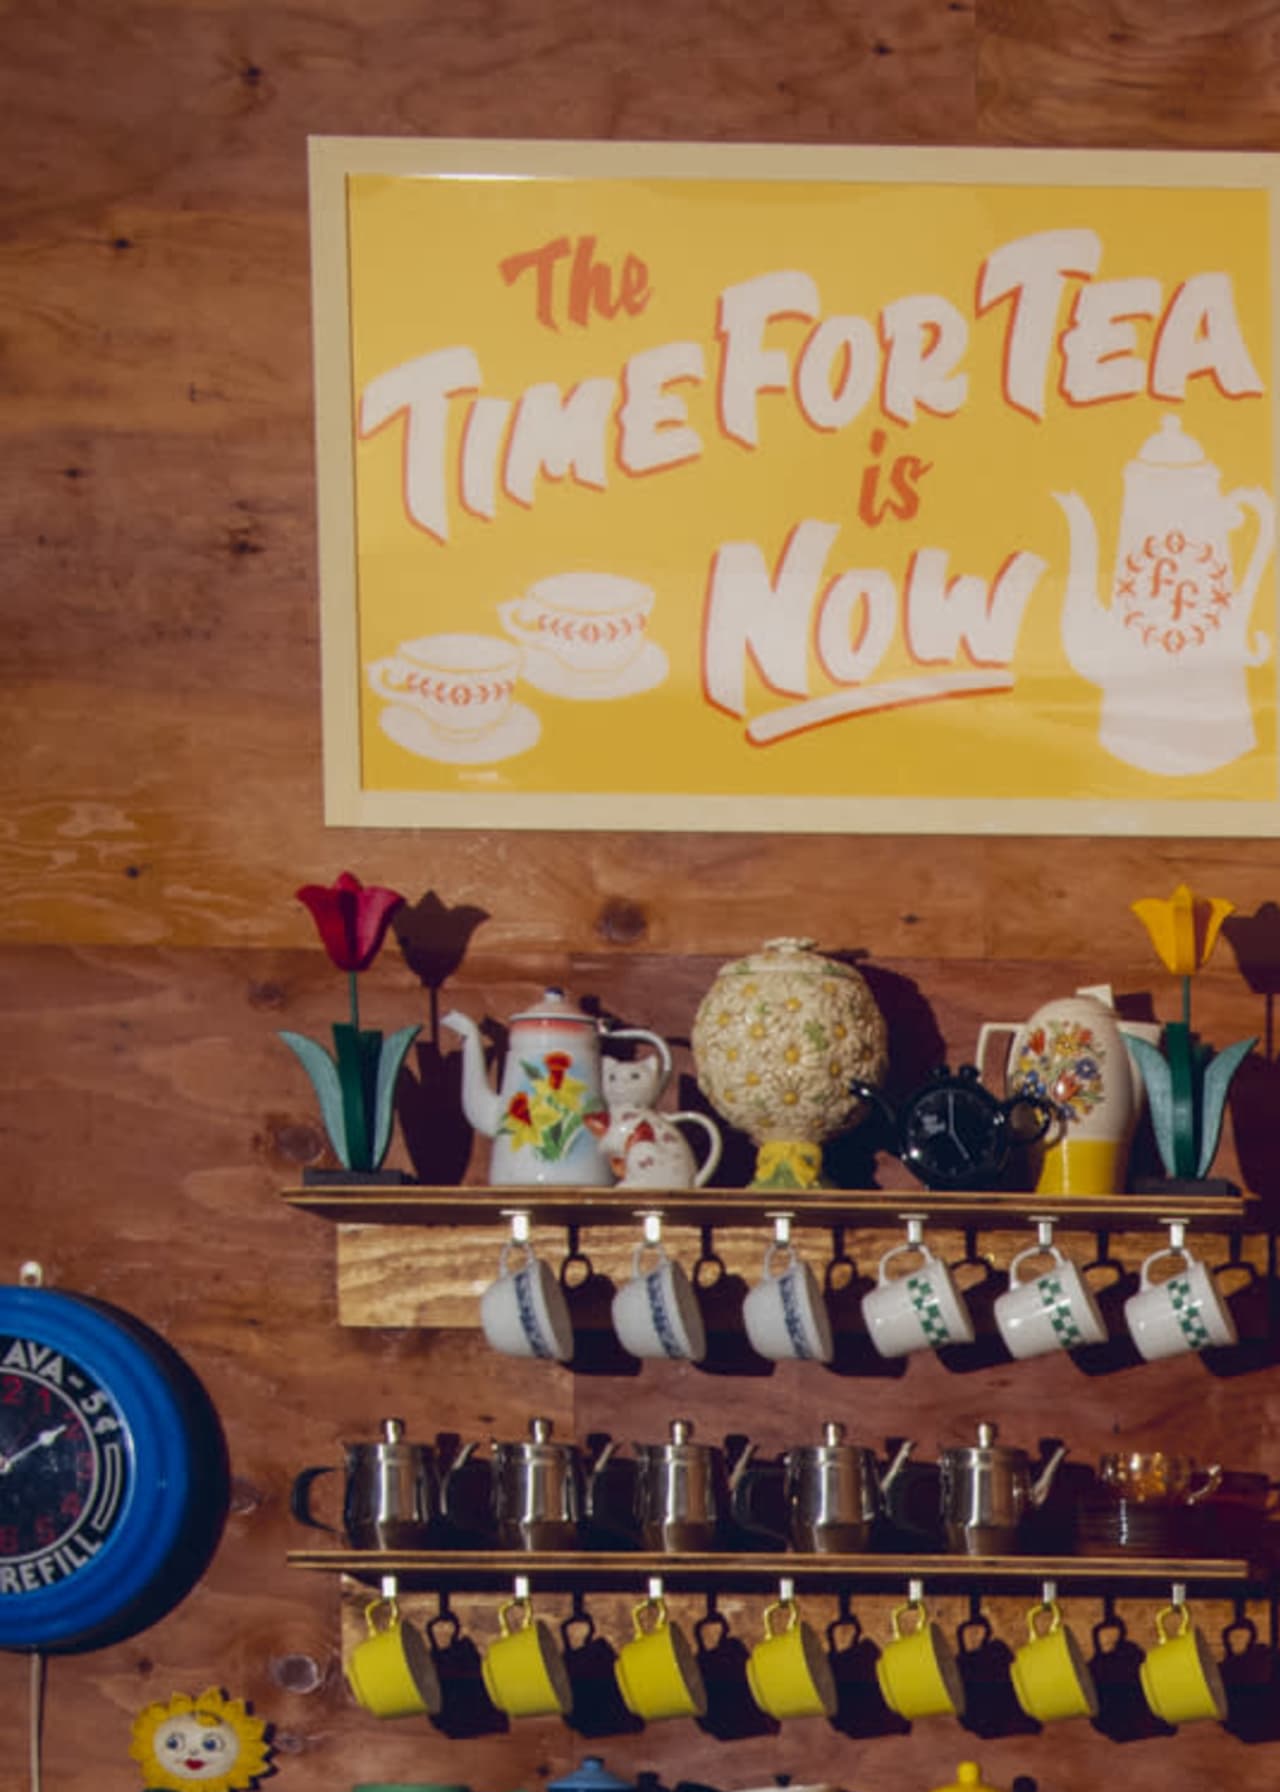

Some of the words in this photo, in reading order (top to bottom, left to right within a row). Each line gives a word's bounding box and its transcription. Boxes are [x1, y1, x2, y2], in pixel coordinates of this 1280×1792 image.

[497, 234, 653, 333] The
[357, 339, 709, 548] TIME
[714, 269, 969, 453] FOR
[974, 227, 1265, 425] TEA
[857, 427, 935, 528] is
[701, 518, 1050, 722] NOW
